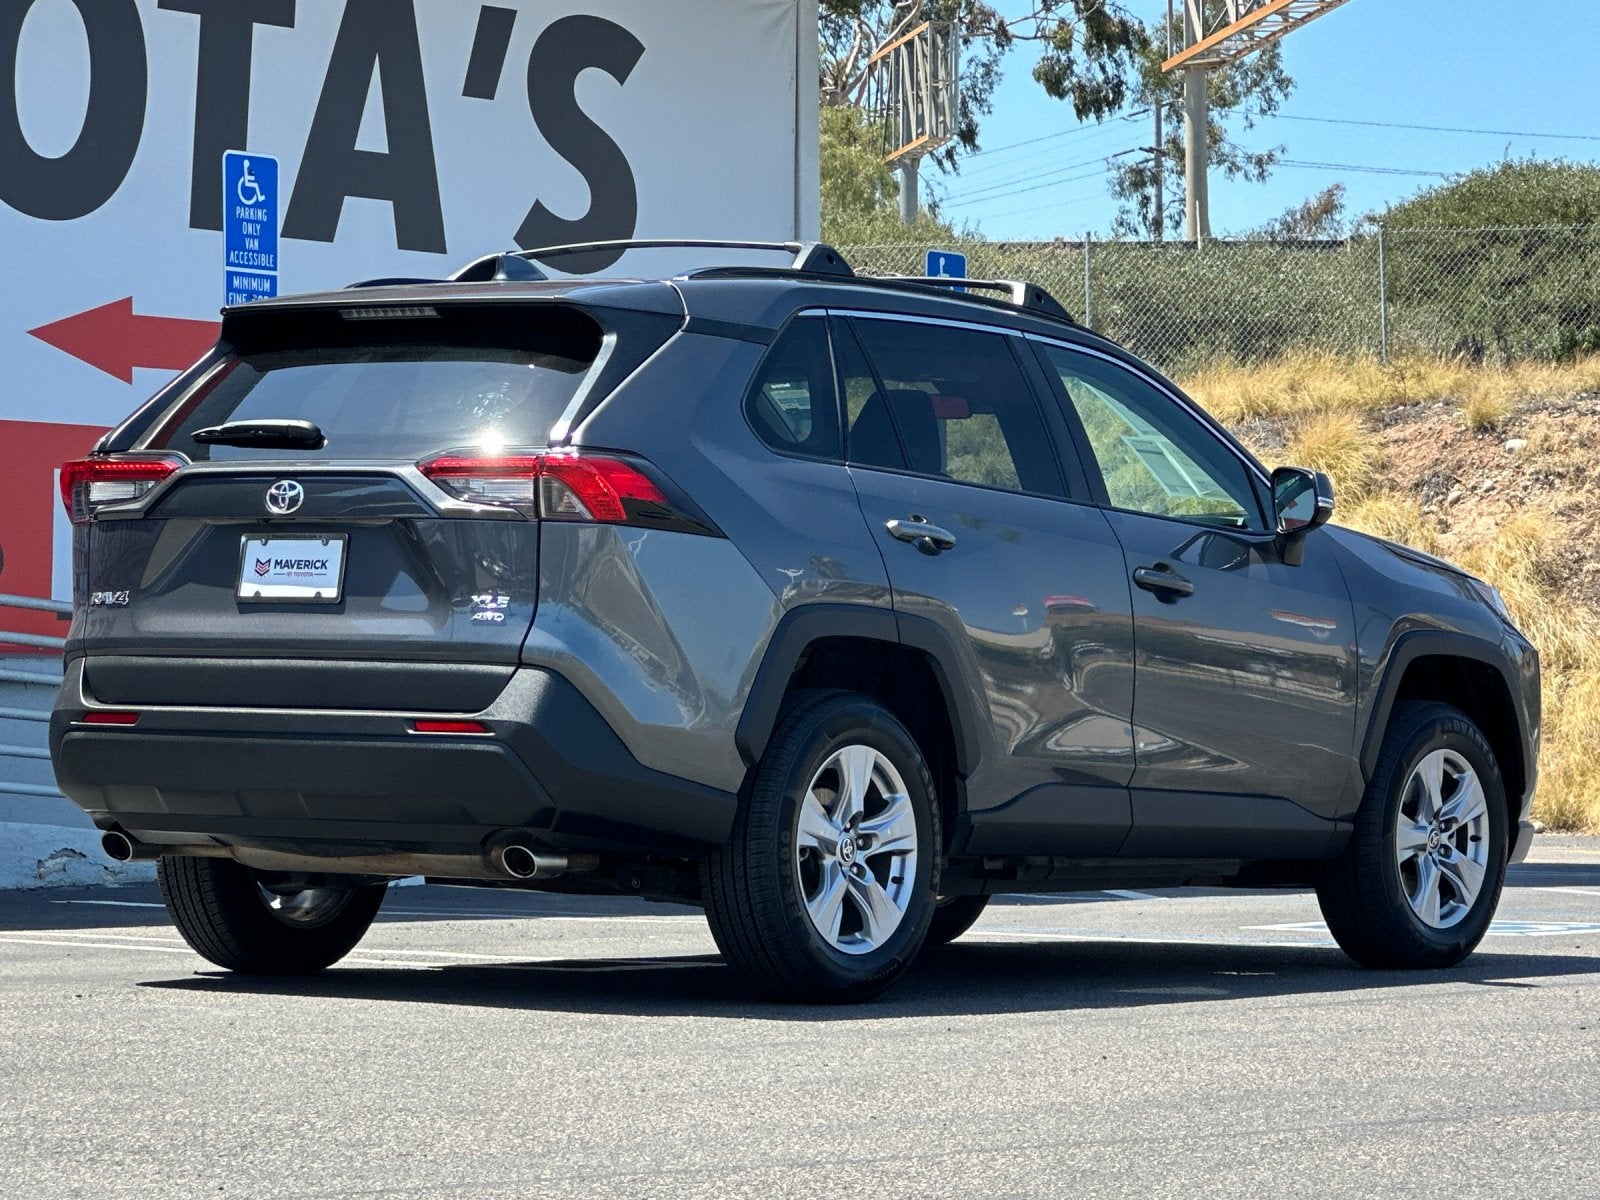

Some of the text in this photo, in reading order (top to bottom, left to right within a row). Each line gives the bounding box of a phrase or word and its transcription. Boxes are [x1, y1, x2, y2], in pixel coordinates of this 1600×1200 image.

[236, 206, 267, 221] PARKING
[242, 221, 261, 236] ONLY
[245, 237, 259, 250] VAN
[229, 251, 274, 267] ACCESSIBLE
[233, 275, 270, 292] MINIMUM
[273, 559, 329, 570] MAVERICK
[90, 590, 130, 605] RAV4
[469, 595, 510, 608] XLE
[470, 611, 505, 621] AWD
